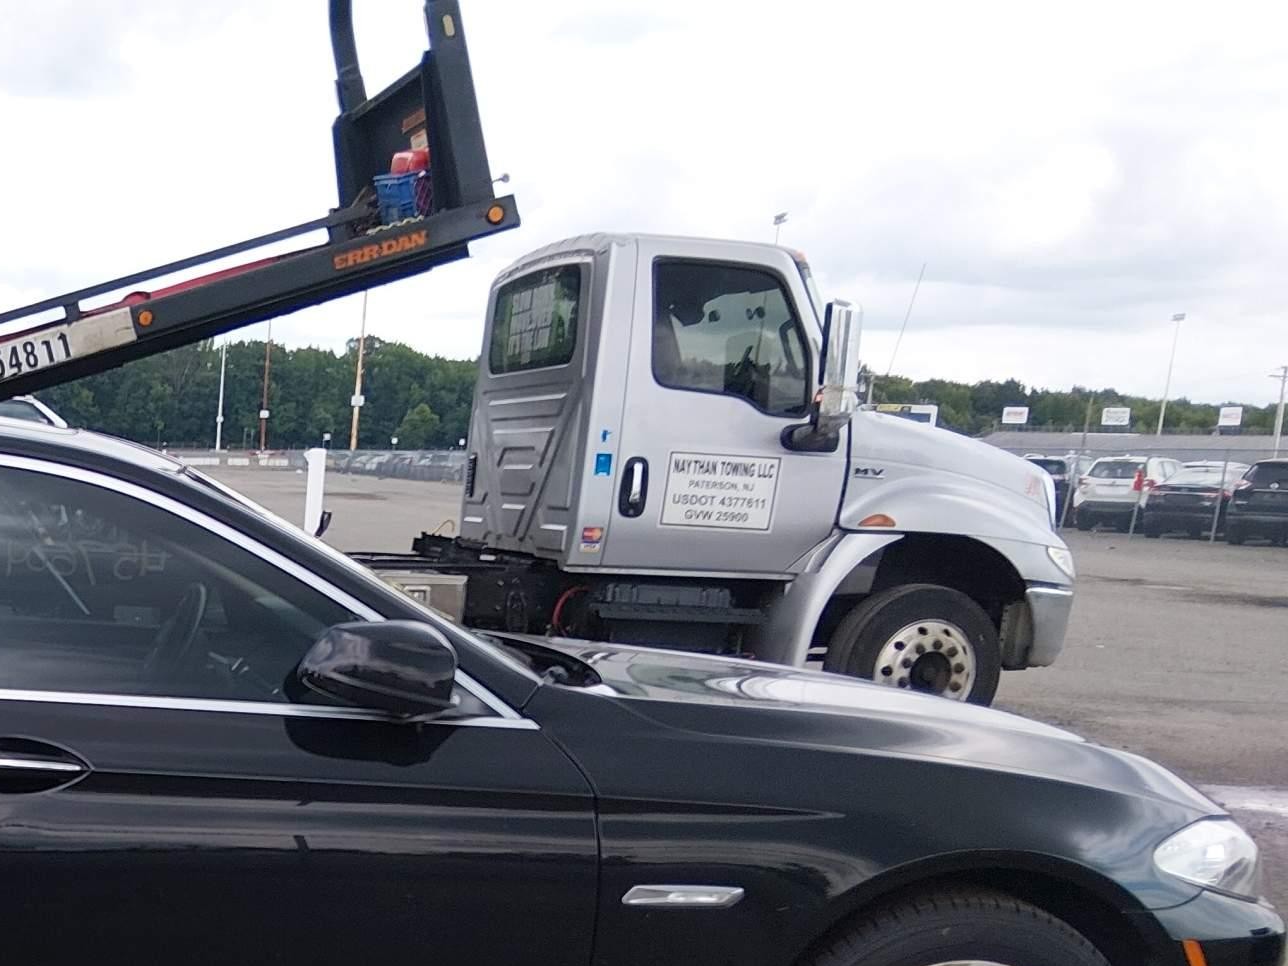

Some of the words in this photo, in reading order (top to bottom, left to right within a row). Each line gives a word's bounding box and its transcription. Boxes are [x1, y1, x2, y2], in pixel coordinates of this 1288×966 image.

[720, 461, 756, 478] TOWING
[757, 463, 775, 479] LLC
[672, 493, 716, 506] USDOT
[684, 509, 713, 521] GVW
